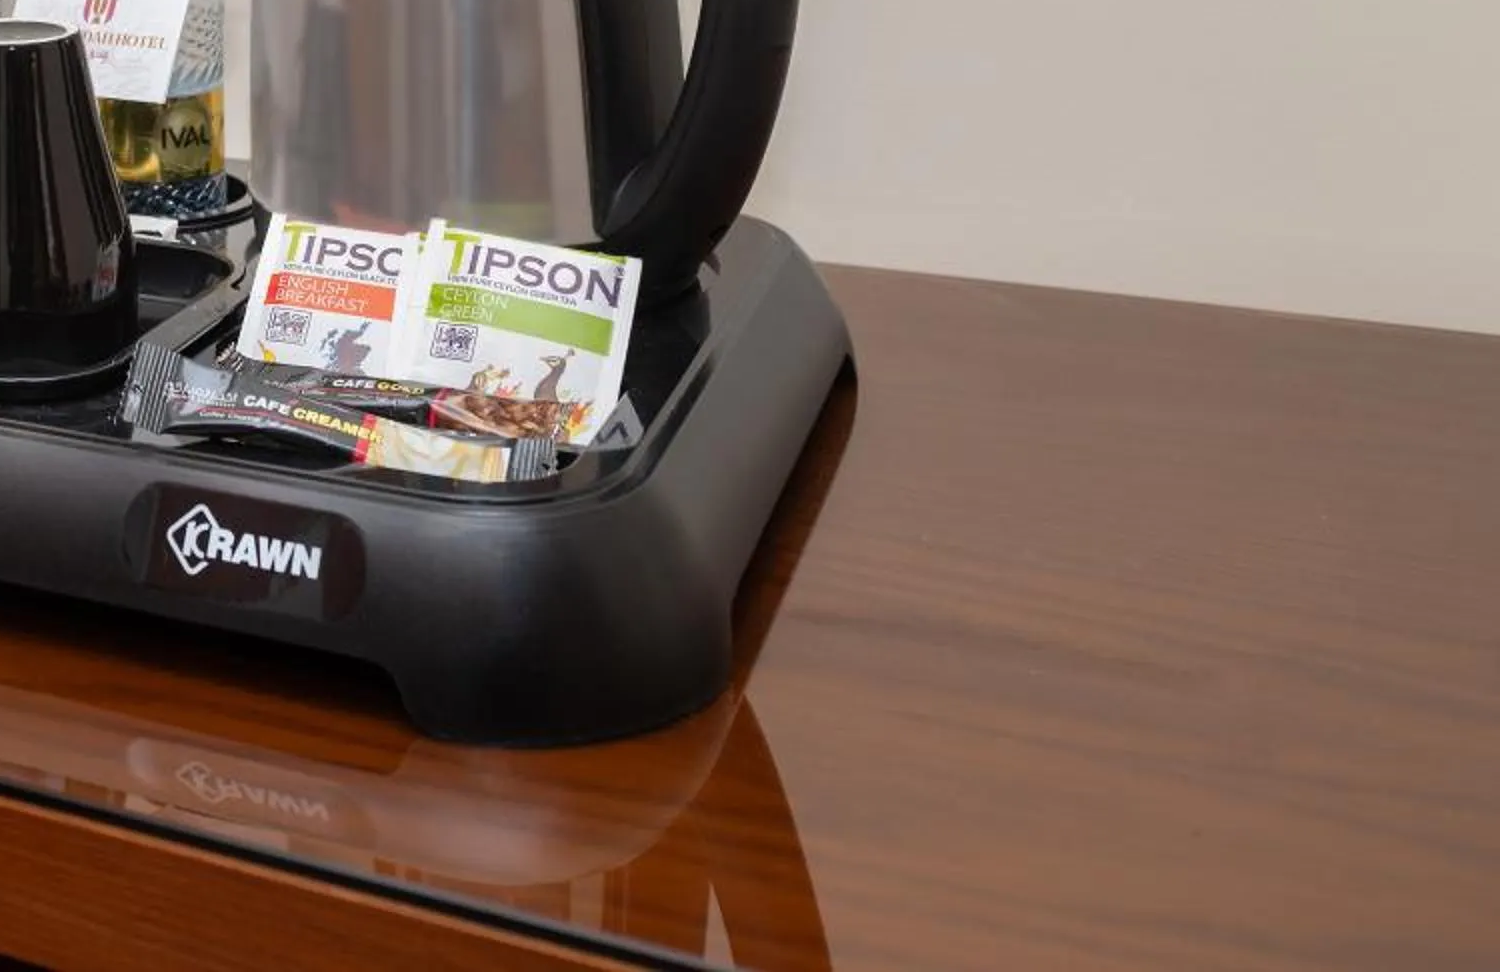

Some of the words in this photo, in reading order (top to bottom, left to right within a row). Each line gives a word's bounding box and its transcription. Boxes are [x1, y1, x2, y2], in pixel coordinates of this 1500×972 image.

[115, 32, 165, 49] HOTEL
[283, 221, 403, 276] TIPSO
[444, 232, 623, 308] TIPSON
[278, 274, 349, 296] ENGLISH
[275, 288, 369, 312] BREAKFAST
[443, 287, 509, 309] CEYLON
[441, 303, 494, 324] GREEN
[333, 378, 375, 390] CAFE
[243, 394, 292, 415] CAFE
[292, 407, 384, 443] CREAMER
[180, 518, 322, 580] KRAWN
